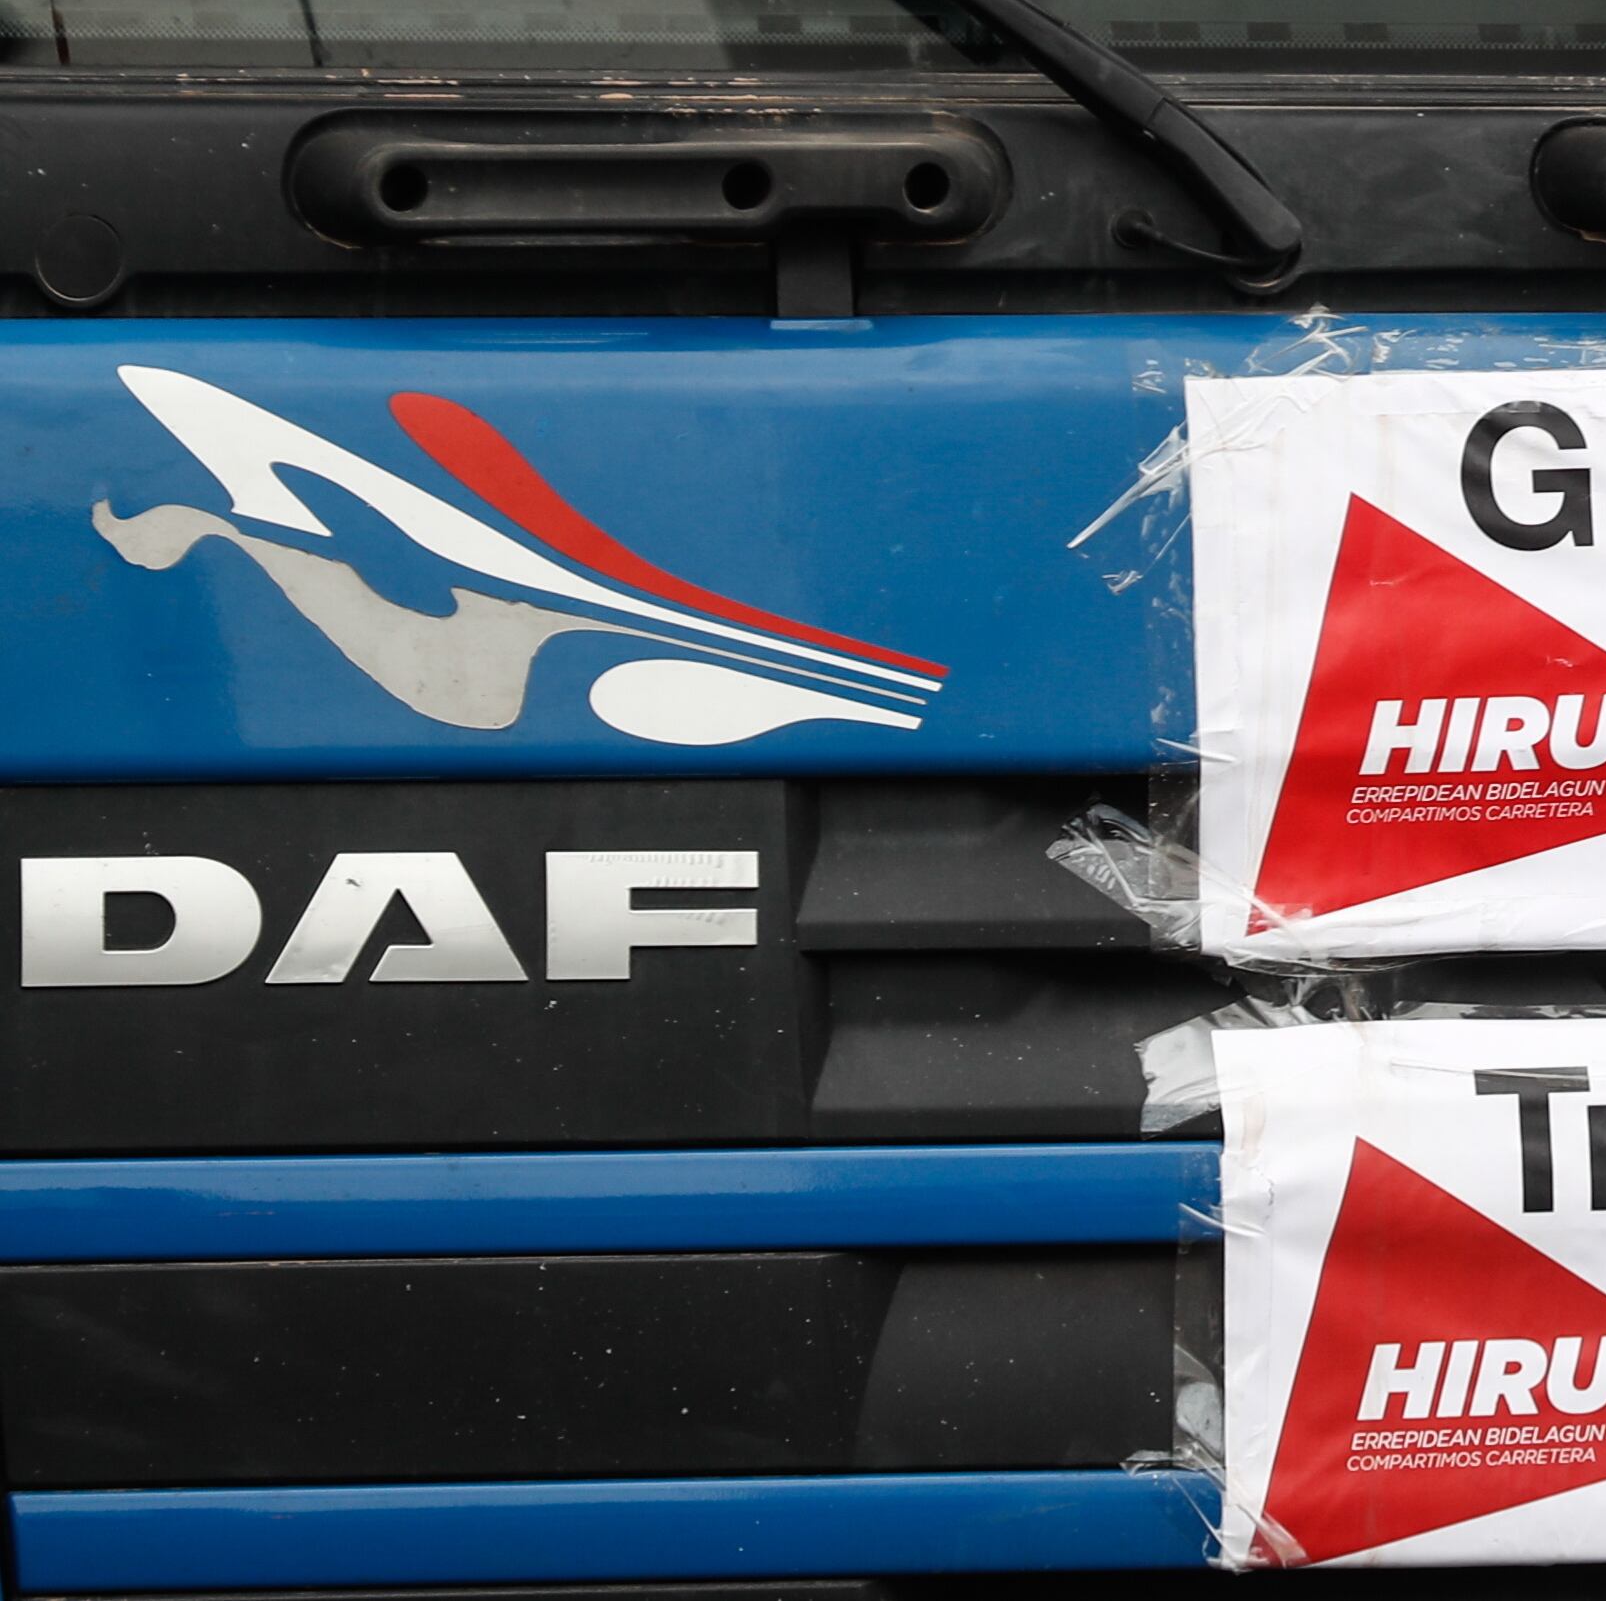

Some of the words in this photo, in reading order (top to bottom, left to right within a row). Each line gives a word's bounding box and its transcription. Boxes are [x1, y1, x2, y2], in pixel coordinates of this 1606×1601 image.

[1350, 784, 1483, 804] ERREPIDEAN
[1485, 780, 1606, 801] BIDELAGUN
[1346, 806, 1481, 824] COMPARTIMOS
[1485, 802, 1594, 821] CARRETERA
[20, 851, 760, 987] DAF
[1350, 1429, 1482, 1451] ERREPIDEAN
[1485, 1424, 1606, 1447] BIDELAGUN
[1346, 1452, 1482, 1472] COMPARTIMOS
[1485, 1447, 1596, 1468] CARRETERA
